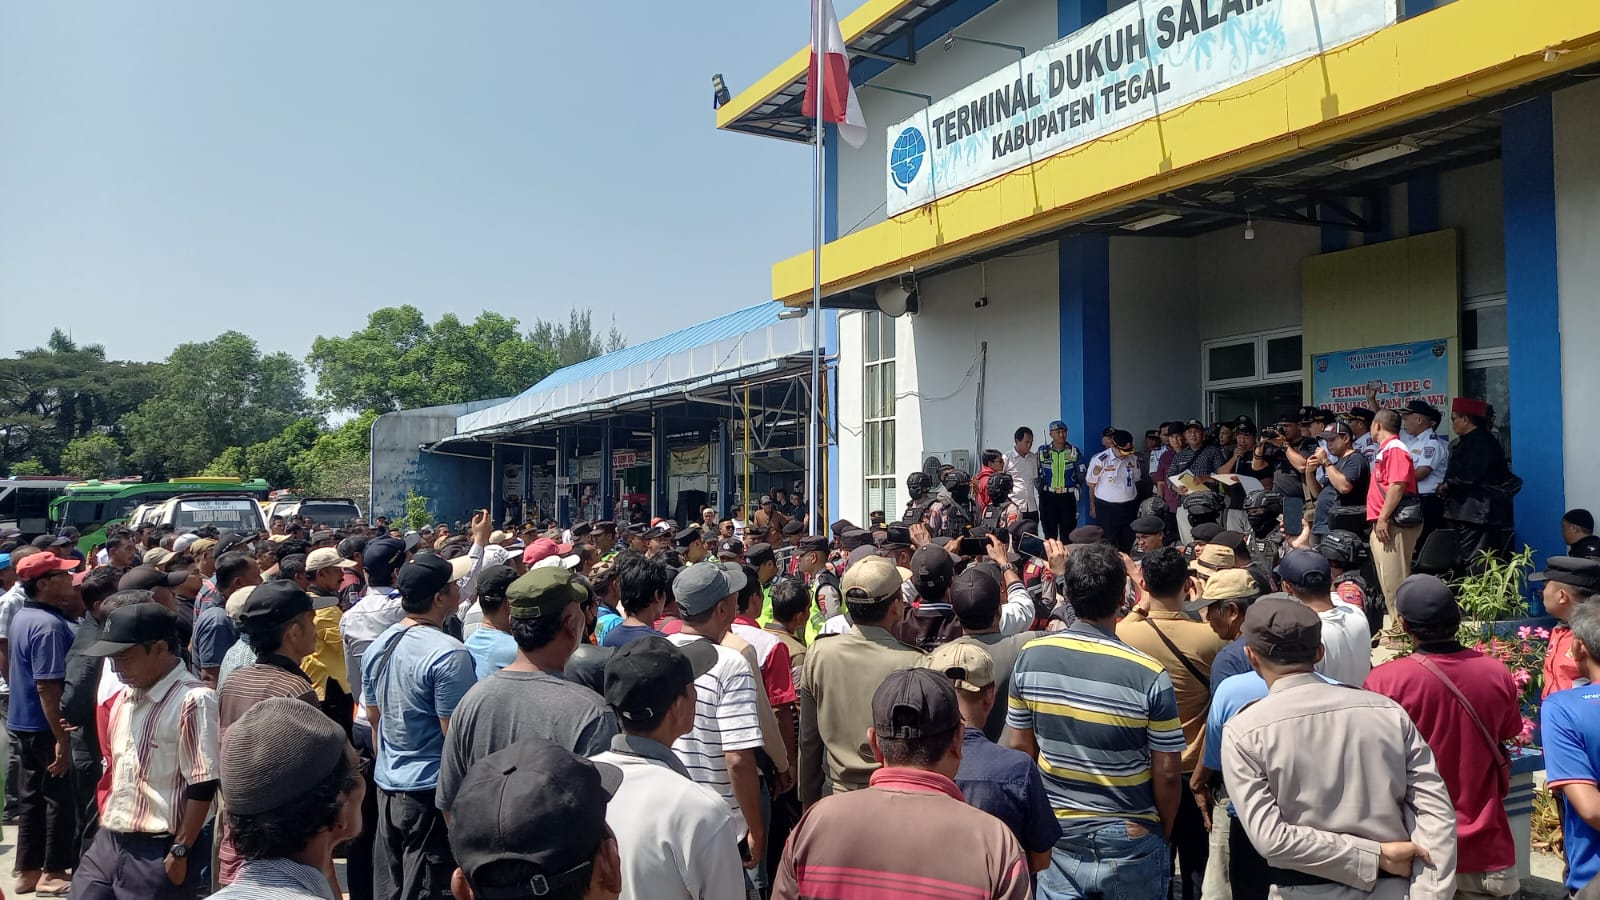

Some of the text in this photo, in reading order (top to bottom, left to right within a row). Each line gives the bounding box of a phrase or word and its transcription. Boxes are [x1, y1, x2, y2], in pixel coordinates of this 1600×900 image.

[932, 0, 1272, 150] TERMINAL DUKUH SALA
[992, 65, 1171, 160] KABUPATEN TEGAL
[1330, 379, 1432, 398] TERMIAL TIPE C
